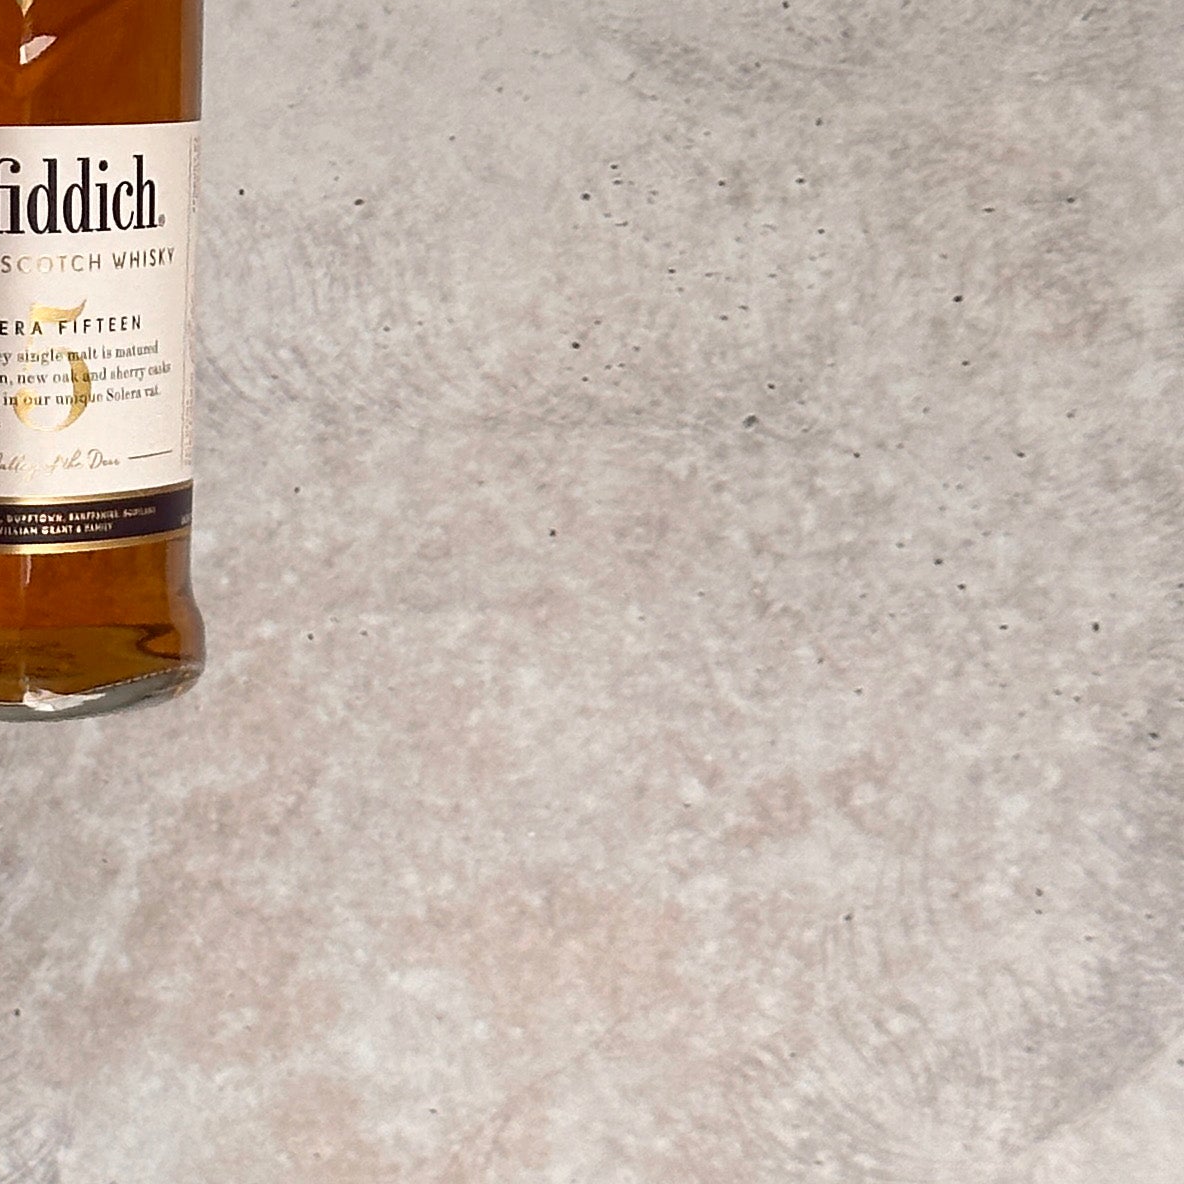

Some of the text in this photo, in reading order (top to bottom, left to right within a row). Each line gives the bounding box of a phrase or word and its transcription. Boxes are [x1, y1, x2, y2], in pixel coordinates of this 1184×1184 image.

[1, 254, 101, 273] SCOTCH
[112, 247, 175, 268] WHISKY
[58, 314, 141, 335] FIFTEEN
[16, 347, 63, 365] single
[67, 346, 98, 361] malt
[102, 345, 112, 359] is
[115, 339, 159, 358] matured
[17, 372, 48, 384] new
[52, 367, 79, 383] oak
[81, 366, 107, 383] and
[110, 364, 145, 382] sherry
[3, 391, 18, 406] in
[22, 394, 51, 406] our
[55, 391, 104, 408] unique
[106, 386, 142, 402] Solera
[41, 524, 73, 535] GRANT
